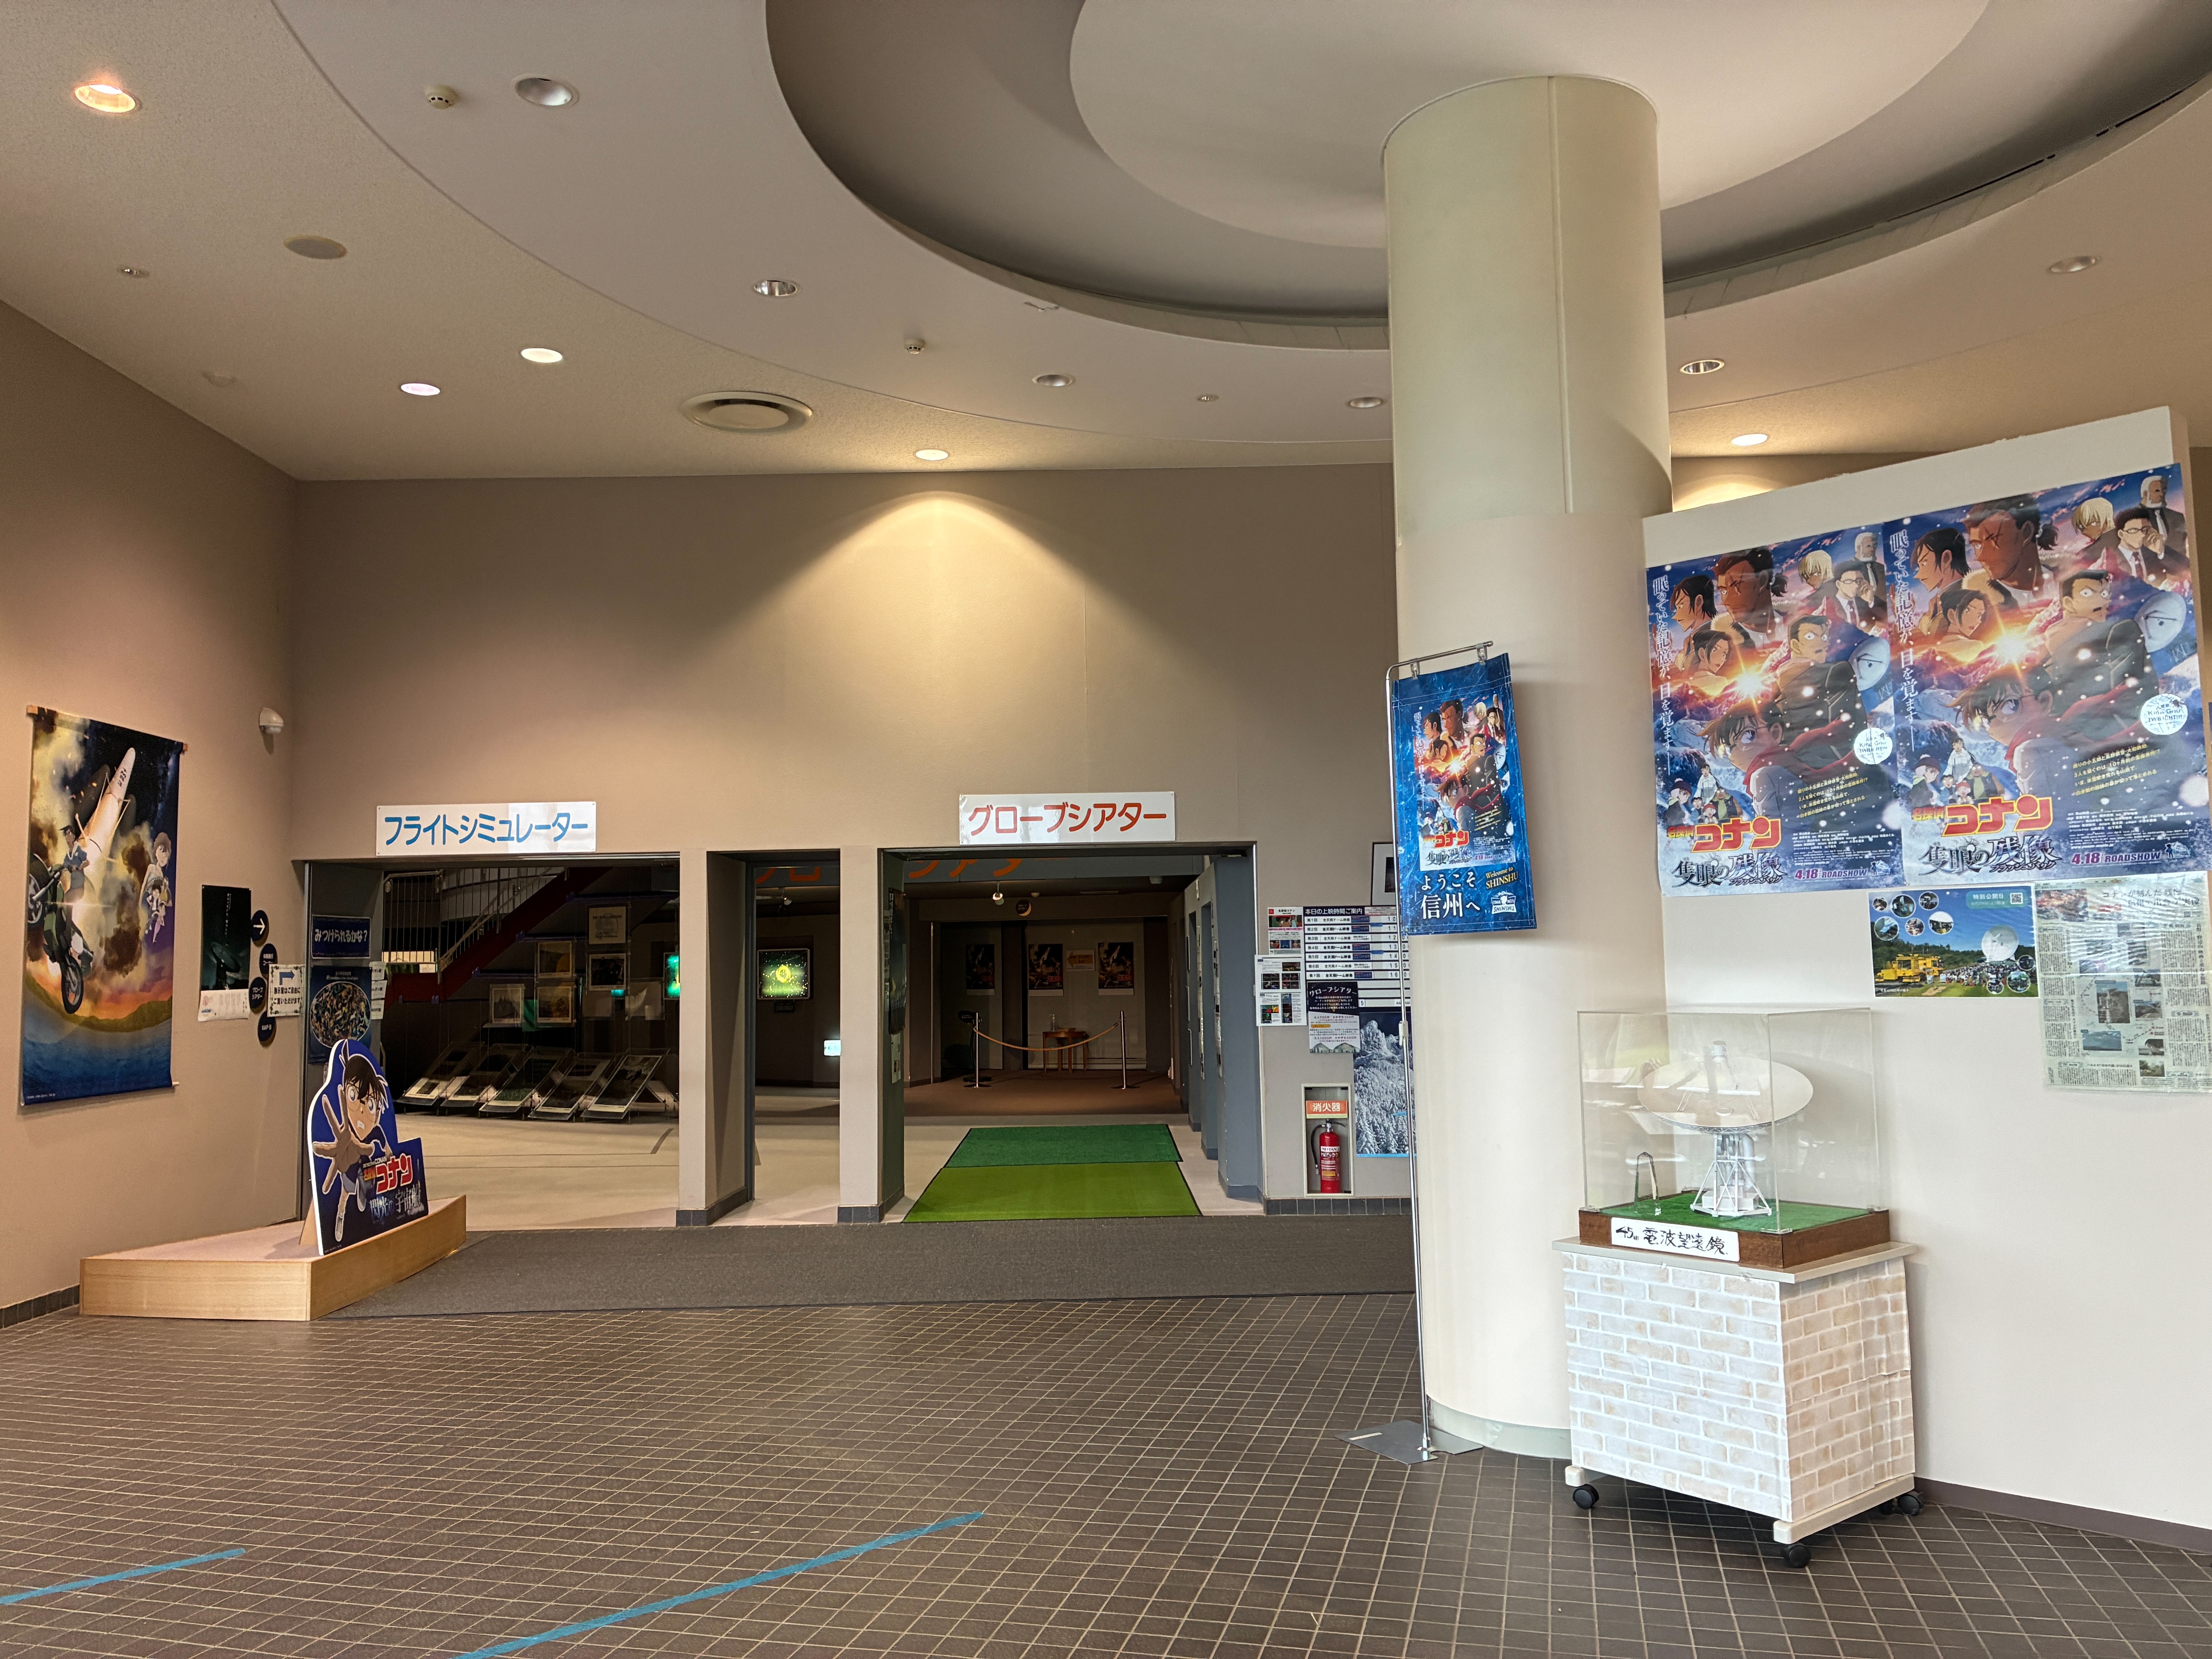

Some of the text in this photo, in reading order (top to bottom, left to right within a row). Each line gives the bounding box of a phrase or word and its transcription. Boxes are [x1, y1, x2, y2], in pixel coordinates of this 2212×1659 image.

[968, 801, 1167, 836] グローブシアター
[1942, 794, 2052, 838] コナン
[385, 812, 588, 845] フライトシミュレーター
[1434, 830, 1470, 849] コナン
[1690, 816, 1782, 853] コナン
[1919, 836, 2063, 875] 隻眼の残像
[2071, 851, 2161, 865] 4.18 ROADSHOW
[1422, 872, 1476, 890] ようこそ
[1486, 869, 1508, 879] Welcome
[1486, 871, 1518, 889] SHINSHU
[1671, 853, 1788, 888] 隻眼の残像
[1795, 869, 1868, 879] 4.18 ROADSHOW
[1420, 892, 1480, 919] 信州へ
[314, 929, 368, 943] みつけられるかな？
[1312, 1102, 1341, 1112] 消火器
[376, 1153, 413, 1195] コナン
